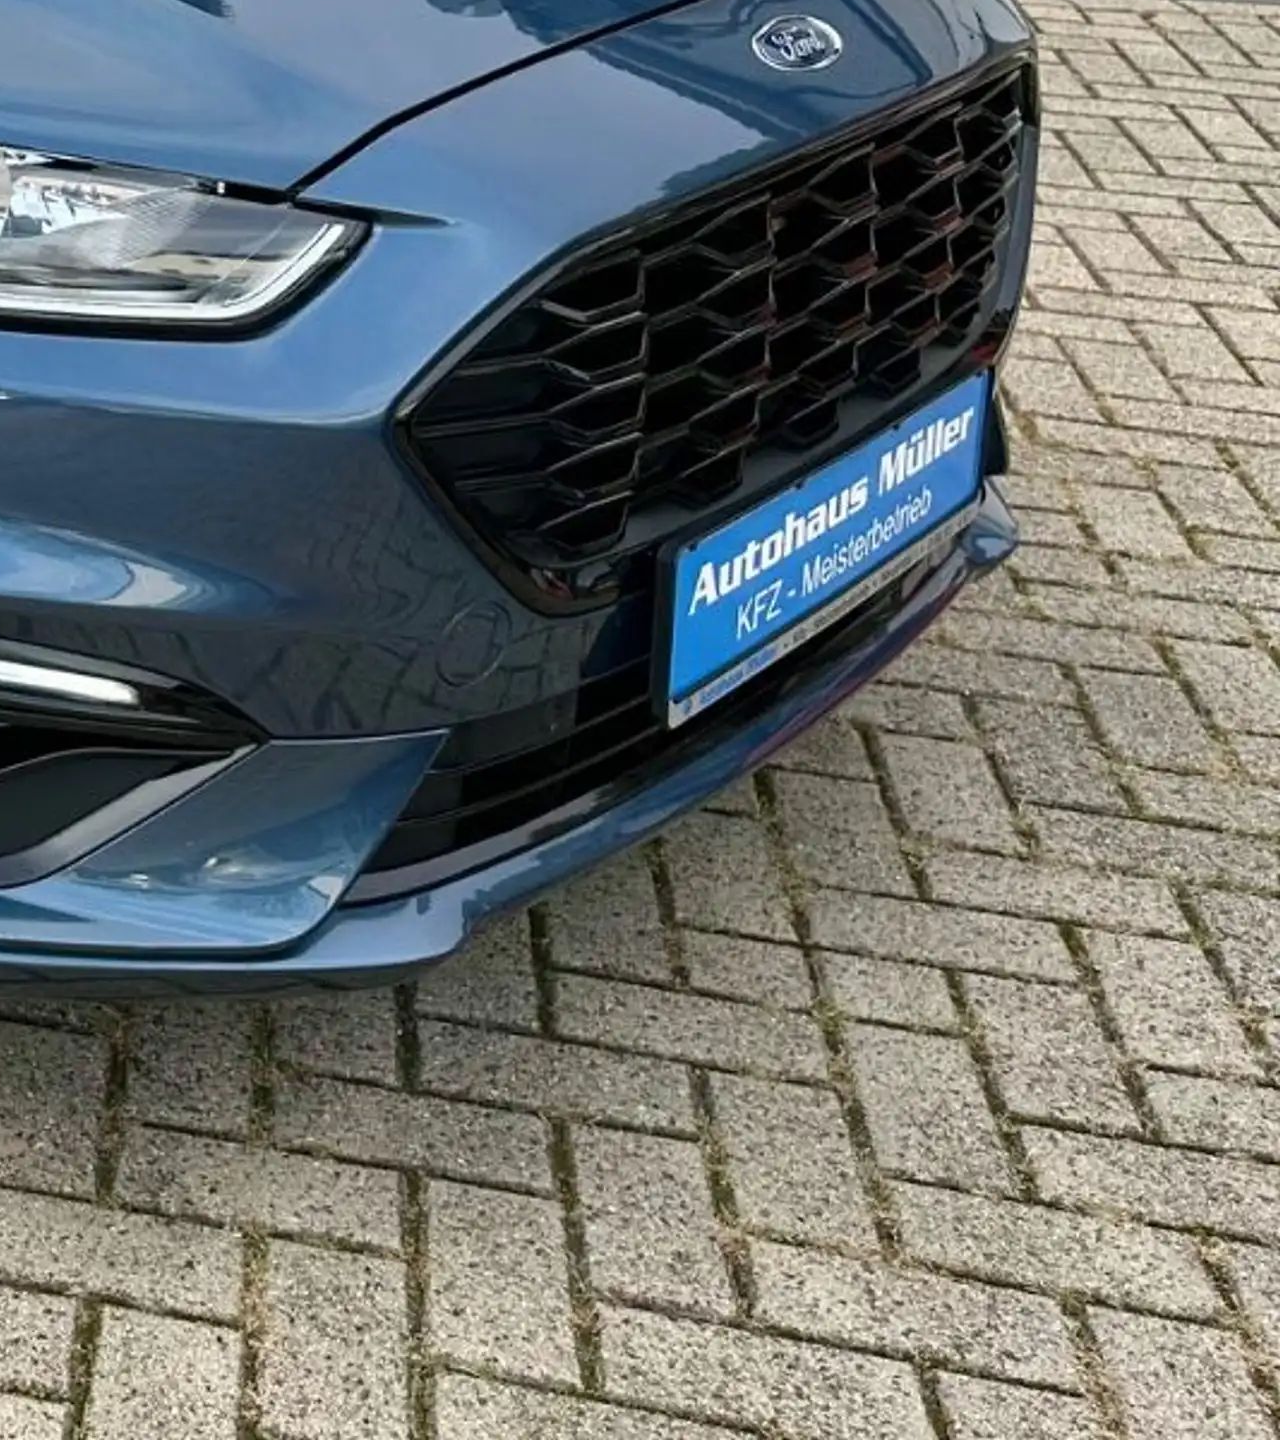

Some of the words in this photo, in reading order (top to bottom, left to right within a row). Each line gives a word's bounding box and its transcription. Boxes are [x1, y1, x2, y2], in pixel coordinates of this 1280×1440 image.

[770, 25, 826, 61] Ford
[688, 476, 868, 616] Autohaus
[878, 407, 974, 497] Müller
[736, 579, 782, 639] KFZ
[802, 486, 933, 598] Meisterbetrieb
